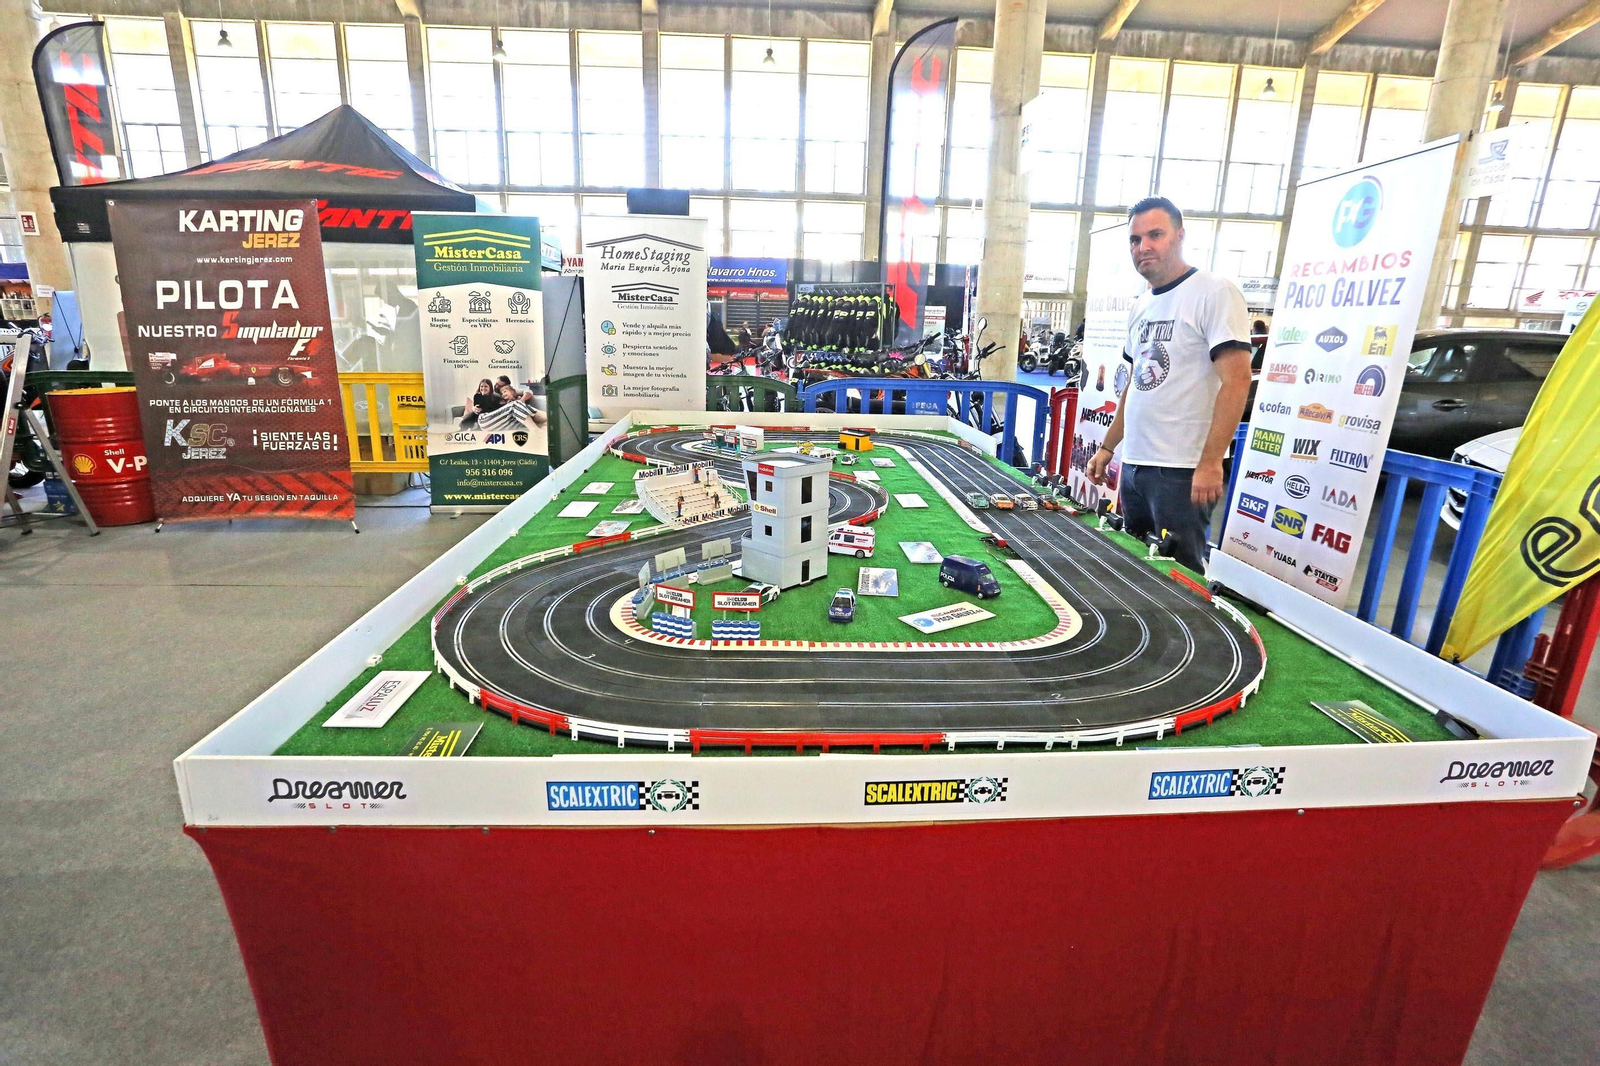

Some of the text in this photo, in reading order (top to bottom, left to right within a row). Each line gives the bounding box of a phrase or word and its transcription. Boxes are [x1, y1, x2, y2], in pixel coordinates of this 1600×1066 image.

[178, 209, 304, 232] KARTING
[242, 232, 300, 249] JEREZ
[196, 255, 293, 265] www.kartingjerez.com
[433, 246, 522, 260] MisterCasa
[433, 262, 524, 273] Gestión Inmobiliaria
[628, 263, 660, 274] Eugenia
[662, 264, 691, 275] Arjona
[1290, 249, 1413, 279] RECAMBIOS
[707, 266, 778, 277] avarro Hnos.
[156, 279, 300, 310] PILOTA
[617, 292, 674, 302] MisterCasa
[1284, 276, 1407, 309] PACO GALVEZ
[138, 325, 218, 338] NUESTRO
[1317, 335, 1344, 344] AUXOL
[1367, 342, 1388, 356] Eni
[1269, 362, 1298, 374] BAHCO
[1353, 383, 1374, 396] GALFER
[149, 399, 181, 407] PONTE
[191, 399, 208, 407] LOS
[209, 399, 249, 407] MANDOS
[252, 399, 265, 407] DE
[266, 399, 280, 407] UN
[281, 397, 325, 406] FÓRMULA
[327, 398, 333, 406] 1
[397, 395, 424, 403] IFECA
[169, 406, 317, 414] EN CIRCUITOS INTERNACIONALES
[1265, 402, 1292, 416] cofan
[1337, 414, 1382, 431] grovisa
[306, 432, 331, 441] LAS
[454, 433, 477, 442] GICA
[485, 434, 506, 444] API
[1253, 430, 1284, 444] MANN
[104, 448, 125, 456] Shell
[262, 441, 318, 451] FUERZAS
[1251, 439, 1282, 454] FILTER
[1292, 438, 1321, 456] WIX
[182, 447, 227, 460] JEREZ
[1329, 448, 1370, 469] FILTRON
[517, 459, 538, 467] (Cádiz)
[456, 479, 524, 488] info@mistercasa.es
[1286, 479, 1311, 495] HELLA
[225, 492, 241, 502] YA
[254, 494, 285, 502] SESIÓN
[286, 494, 298, 502] EN
[1321, 485, 1358, 511] IADA
[760, 505, 777, 514] Shell
[1240, 497, 1267, 513] SKF
[1273, 511, 1304, 532] SNR
[1229, 537, 1259, 553] HUTCHINSON
[1310, 522, 1352, 554] FAG
[1273, 549, 1297, 568] YUASA
[1313, 569, 1339, 586] STAYER
[670, 595, 691, 604] DREAMER
[359, 680, 402, 712] ESPALUZ
[1439, 759, 1555, 784] Dreamer
[267, 777, 408, 802] Dreamer
[1151, 769, 1231, 798] SCALEXTRIC
[1470, 779, 1519, 788] SLOT
[549, 782, 638, 808] SCALEXTRIC
[865, 780, 958, 804] SCALEXTRIC
